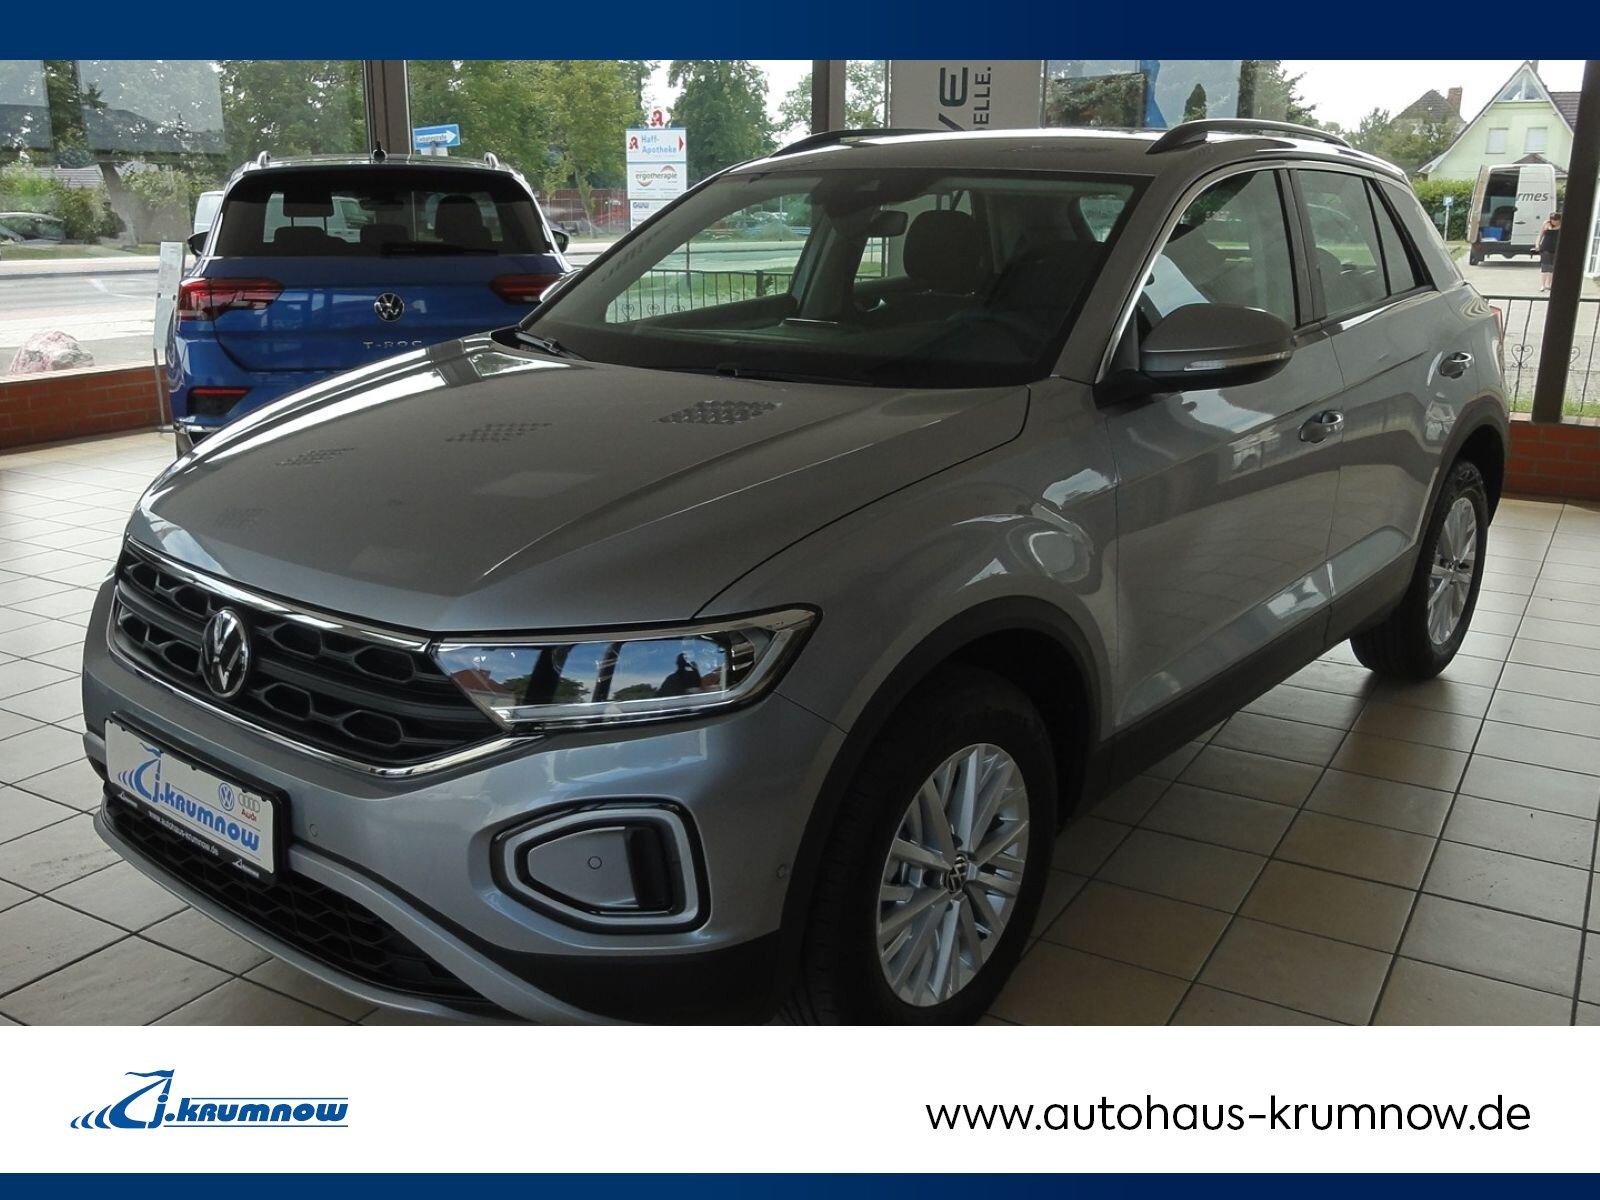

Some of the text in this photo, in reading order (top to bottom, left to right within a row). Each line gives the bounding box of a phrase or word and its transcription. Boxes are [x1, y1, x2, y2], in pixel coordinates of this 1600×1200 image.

[973, 66, 991, 130] ELLE.
[641, 145, 677, 155] Apotheke
[635, 172, 678, 181] ergotherapie
